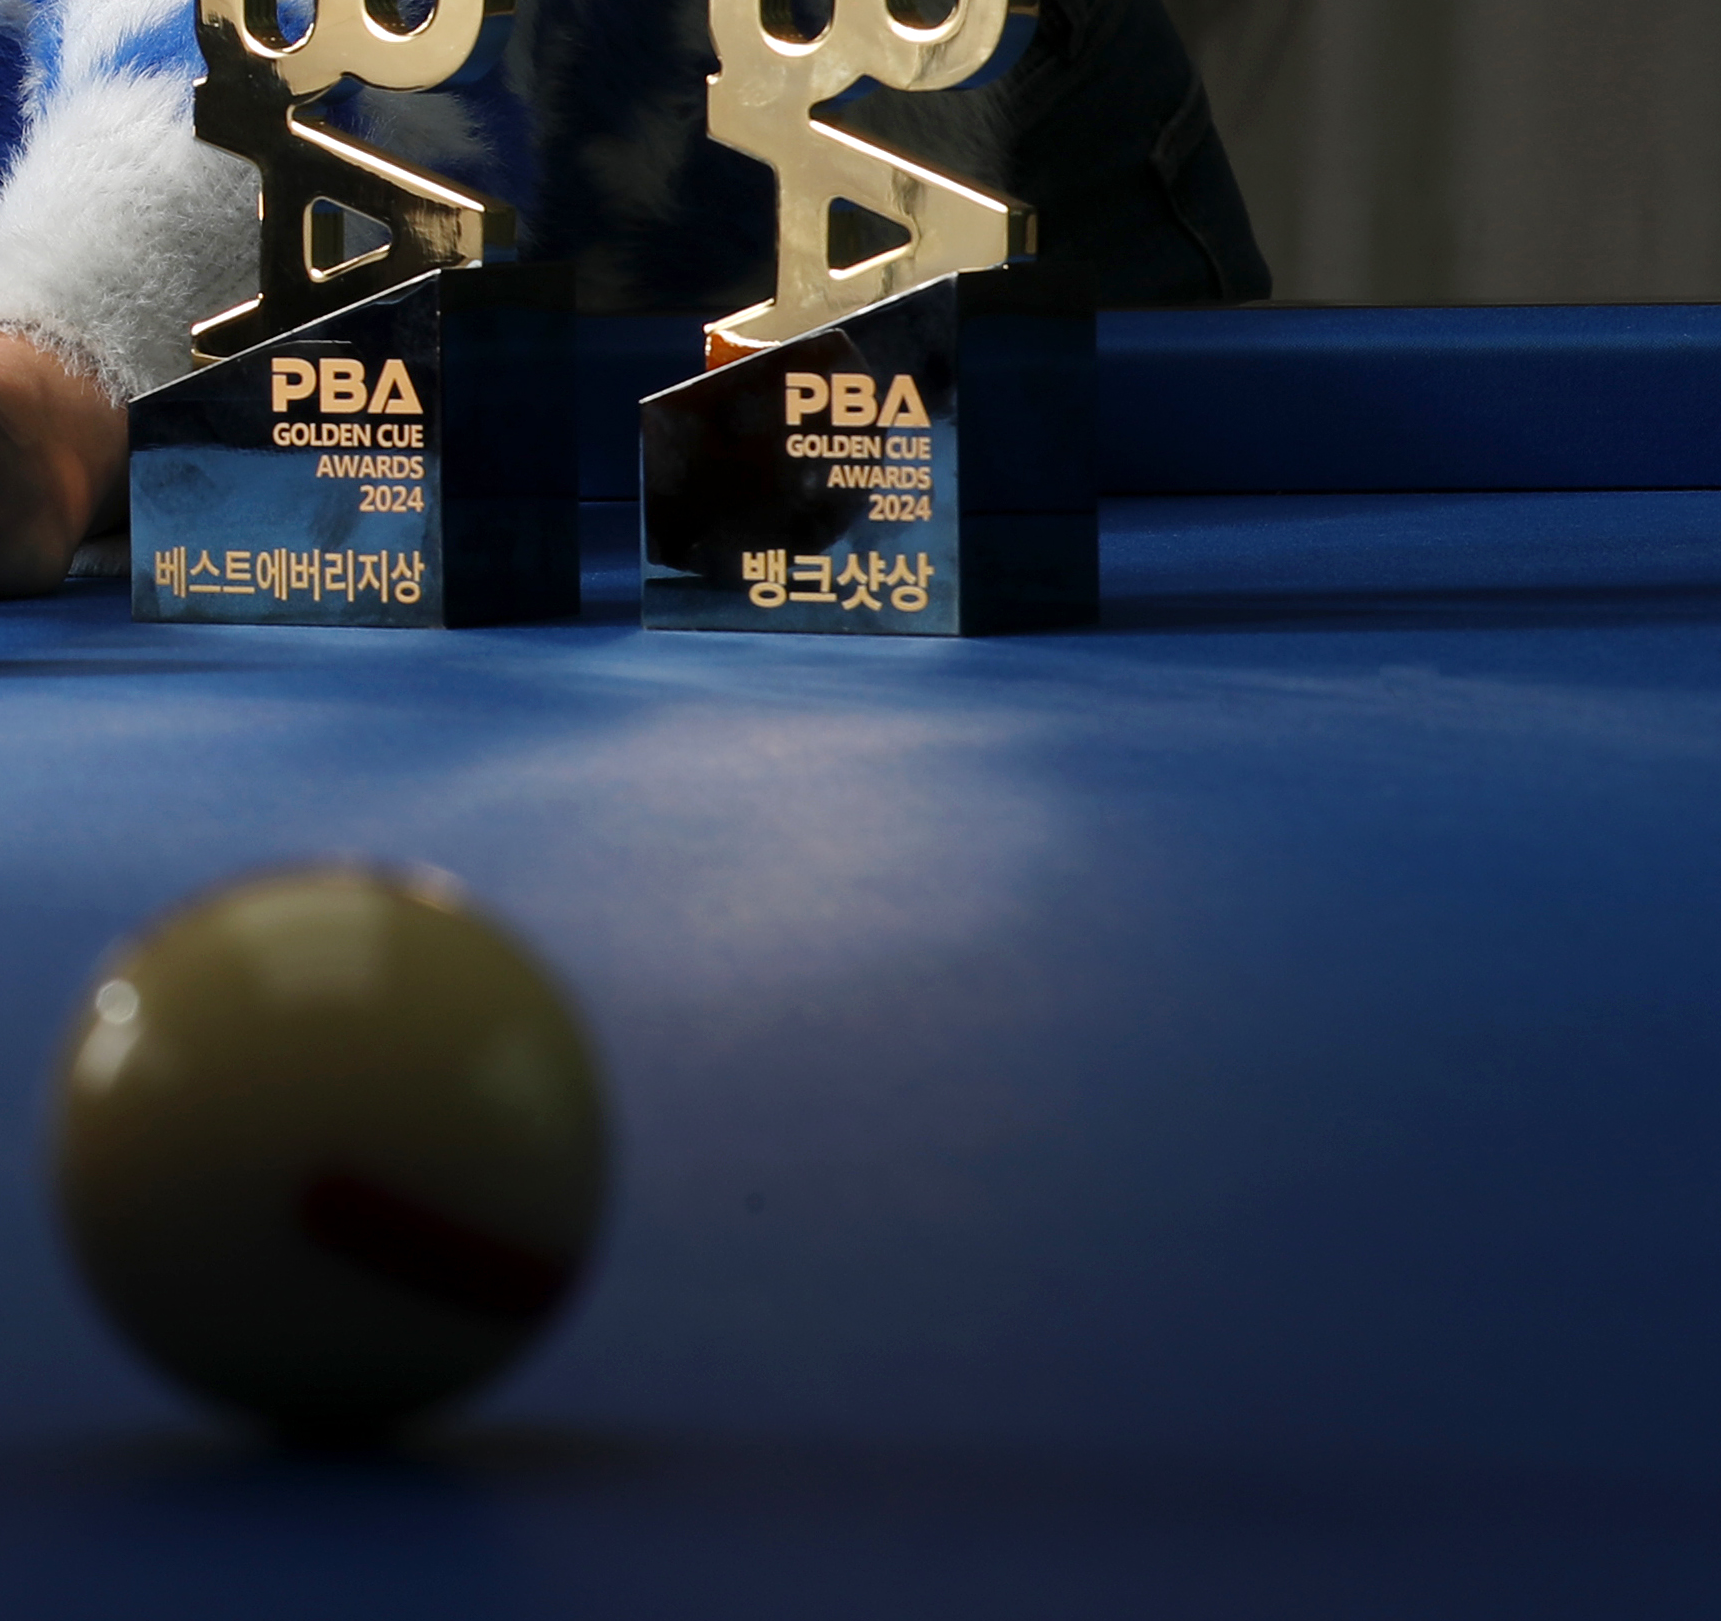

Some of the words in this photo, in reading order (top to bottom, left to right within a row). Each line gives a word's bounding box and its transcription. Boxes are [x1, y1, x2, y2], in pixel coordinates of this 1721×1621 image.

[272, 358, 424, 415] PBA
[786, 373, 931, 428] PBA
[273, 423, 372, 448] GOLDEN
[376, 423, 424, 448] CUE
[786, 434, 882, 460] GOLDEN
[885, 434, 931, 460] CUE
[316, 456, 425, 480] AWARDS
[828, 465, 932, 491] AWARDS
[359, 486, 425, 513] 2024
[869, 495, 932, 522] 2024
[155, 548, 426, 605] 베스트에버리지상
[742, 548, 934, 613] 뱅크샷상
